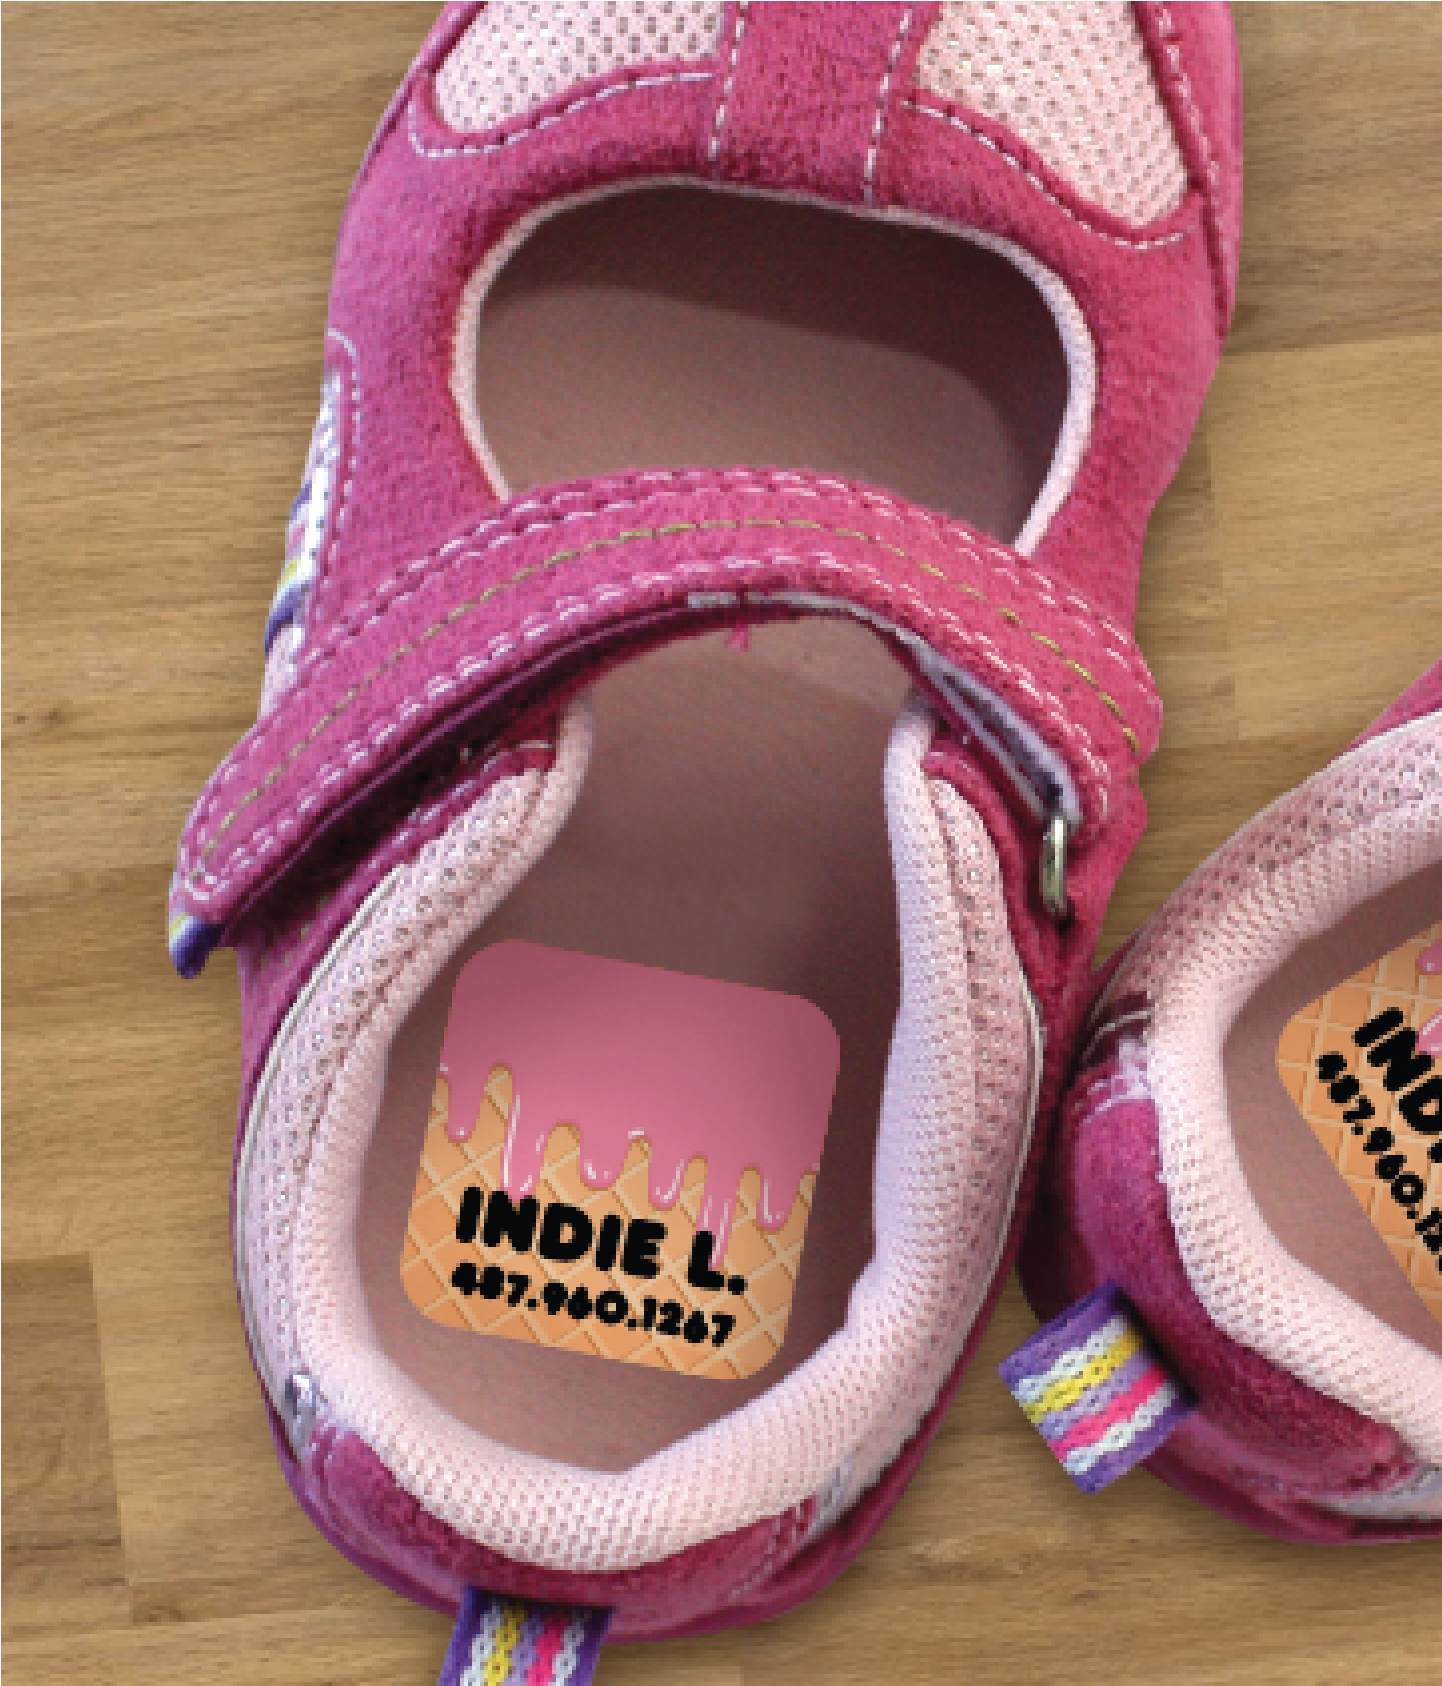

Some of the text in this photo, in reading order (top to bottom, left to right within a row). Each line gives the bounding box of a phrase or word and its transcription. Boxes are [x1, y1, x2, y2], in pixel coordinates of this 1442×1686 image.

[455, 1186, 748, 1295] INDIE L.
[450, 1262, 735, 1347] 487.960.1267
